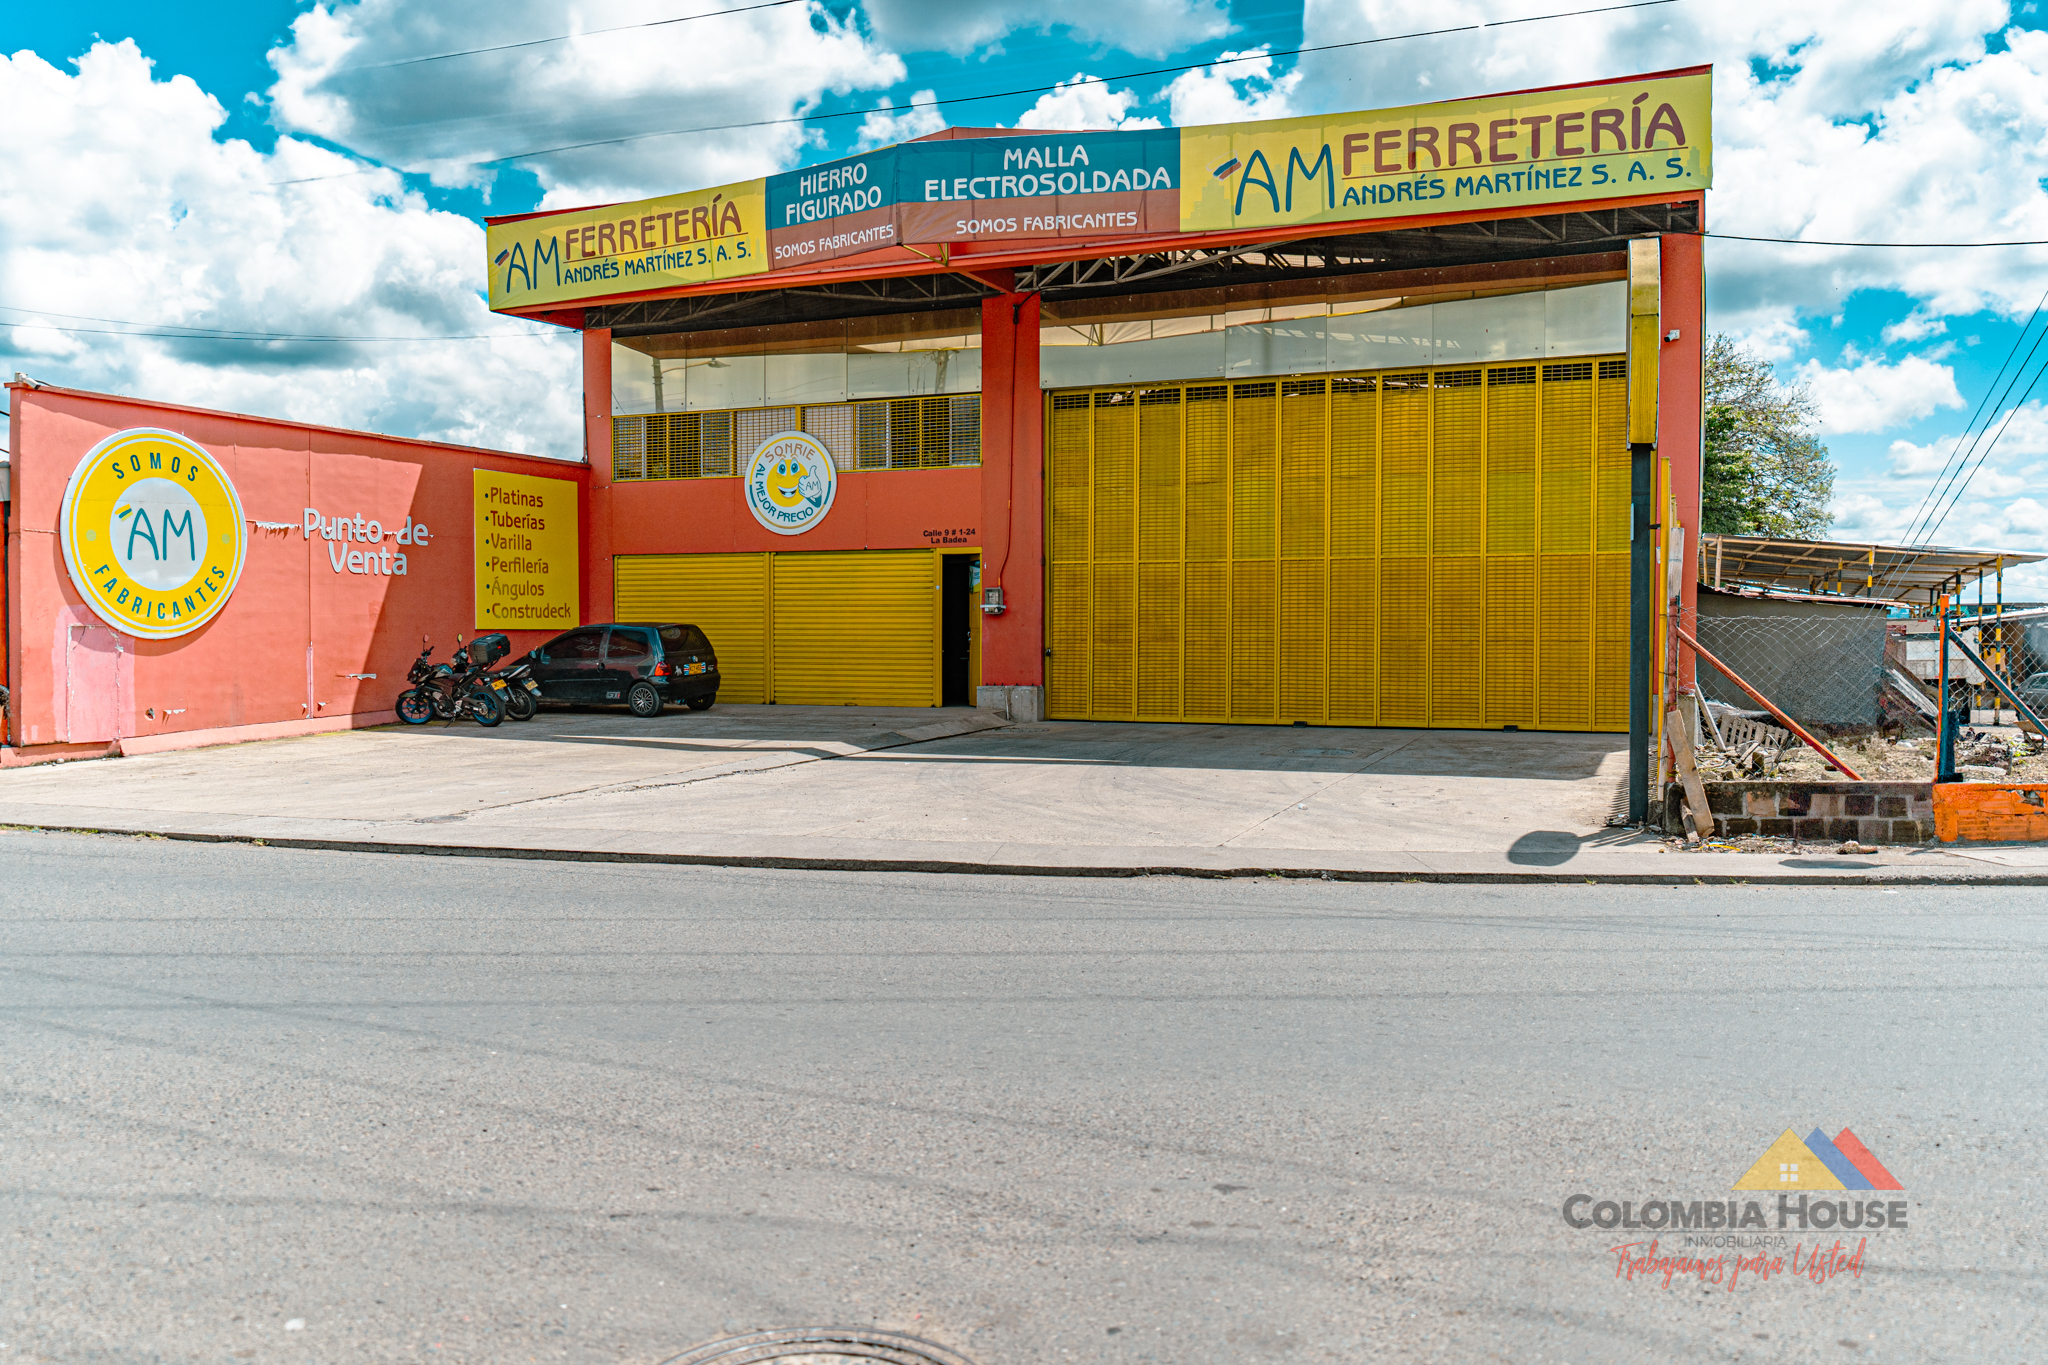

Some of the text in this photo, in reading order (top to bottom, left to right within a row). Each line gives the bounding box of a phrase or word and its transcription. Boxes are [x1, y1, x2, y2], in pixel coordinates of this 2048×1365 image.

[1342, 92, 1686, 177] FERRETERÍA
[1003, 144, 1090, 171] MALLA
[800, 162, 868, 197] HIERRO
[924, 166, 1172, 202] ELECTROSOLDADA
[1234, 143, 1336, 216] AM
[1342, 157, 1692, 207] ANDRÉS MARTÍNEZ S. A. S.
[785, 185, 882, 225] FIGURADO
[565, 193, 743, 260] FERRETERÍA
[955, 211, 1138, 235] SOMOS FABRICANTES
[774, 224, 894, 260] SOMOS FABRICANTES
[506, 236, 561, 294] AM
[564, 241, 752, 285] ANDRÉS MARTÍNEZ S. A. S.
[111, 452, 199, 482] SOMOS
[764, 442, 816, 463] SONRIE
[490, 487, 544, 508] Platinas
[755, 463, 814, 523] AL MEJOR PRECIO
[805, 481, 819, 491] AM
[127, 507, 196, 561] AM
[303, 507, 429, 546] Punto de
[490, 510, 545, 530] Tuberías
[959, 528, 976, 536] 1-24
[490, 532, 532, 551] Varilla
[942, 536, 967, 544] Badea
[328, 541, 408, 575] Venta
[491, 556, 549, 574] Perfilería
[94, 564, 225, 620] FABRICANTES
[491, 576, 545, 601] Ángulos
[492, 602, 571, 619] Construdeck
